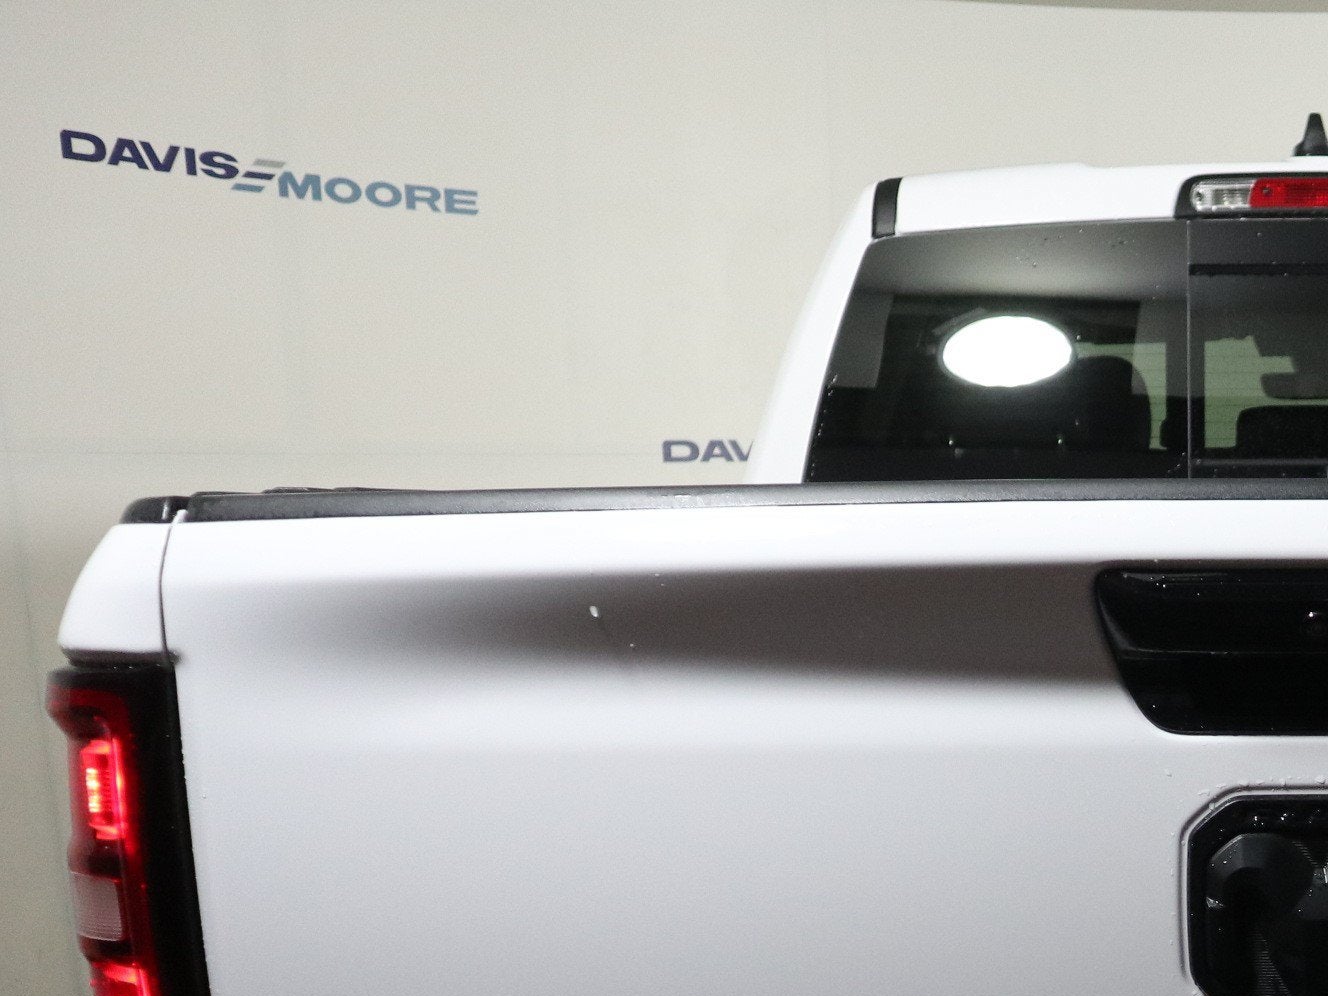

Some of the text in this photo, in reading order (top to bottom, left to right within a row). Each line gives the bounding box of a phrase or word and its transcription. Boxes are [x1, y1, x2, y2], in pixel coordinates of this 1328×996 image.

[59, 129, 479, 215] DAVIS MOORE
[662, 439, 753, 463] DAV
